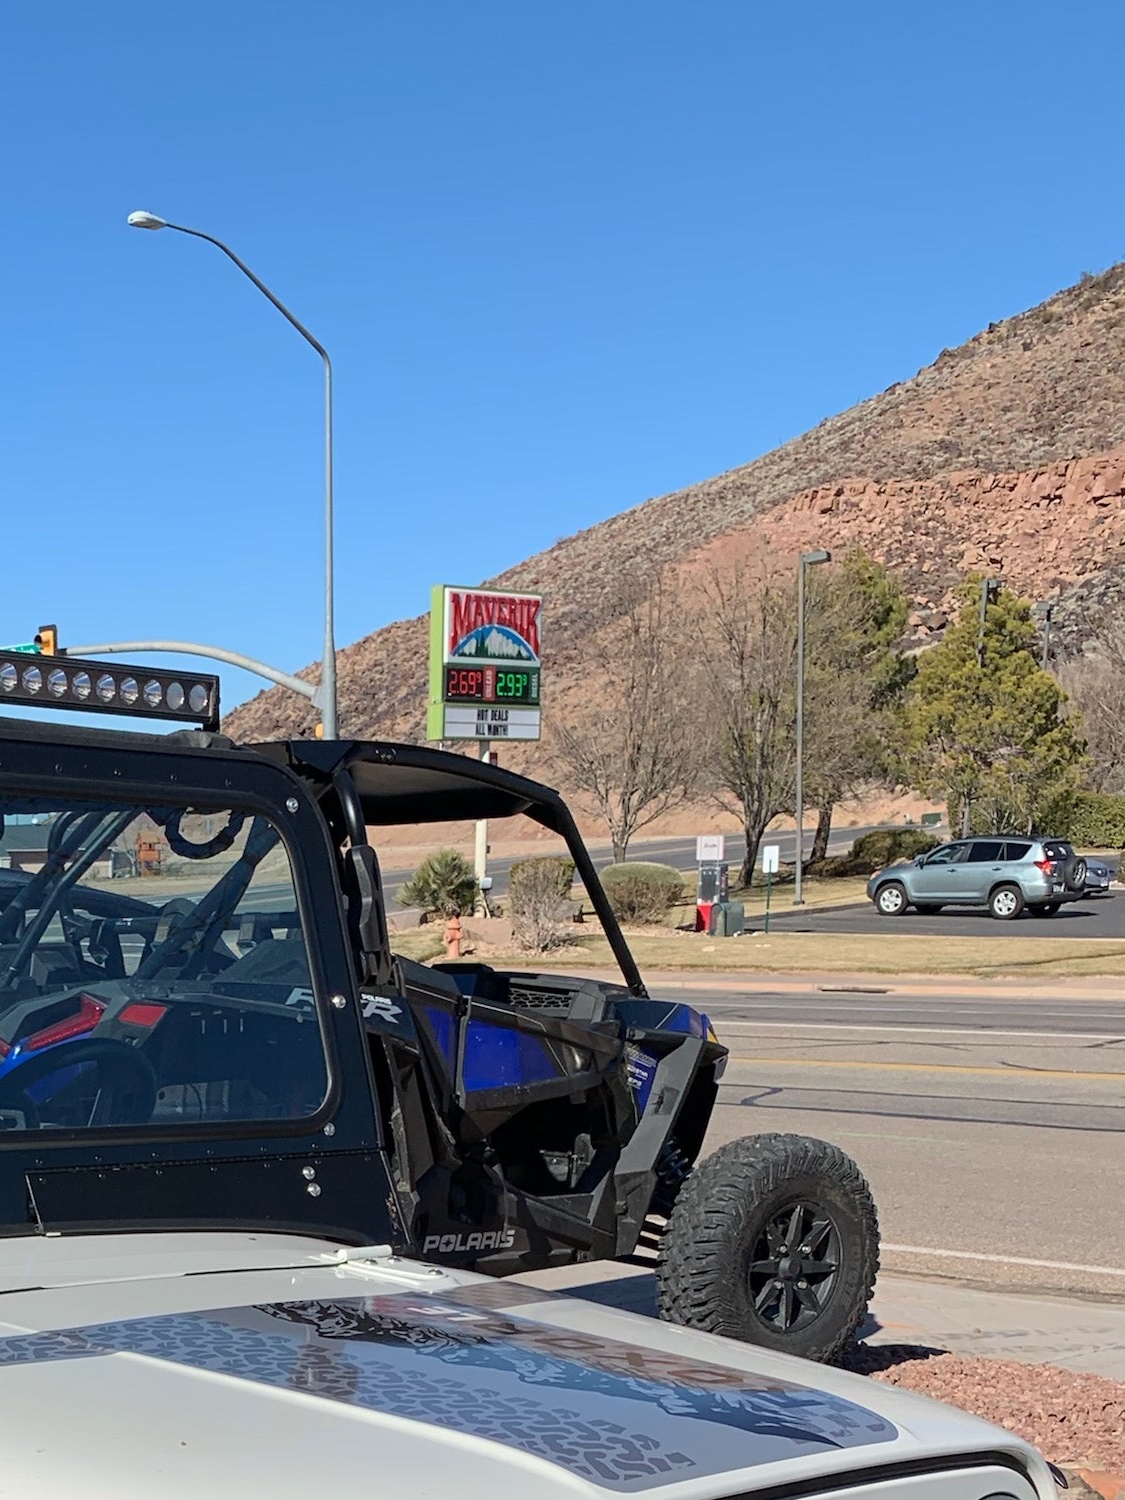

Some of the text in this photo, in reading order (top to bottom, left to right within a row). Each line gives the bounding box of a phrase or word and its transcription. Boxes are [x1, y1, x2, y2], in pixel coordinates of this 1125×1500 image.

[449, 592, 540, 659] MAVERIK
[477, 709, 509, 721] HOT DEALS
[475, 723, 485, 735] ALL
[422, 1229, 516, 1254] POLARIS
